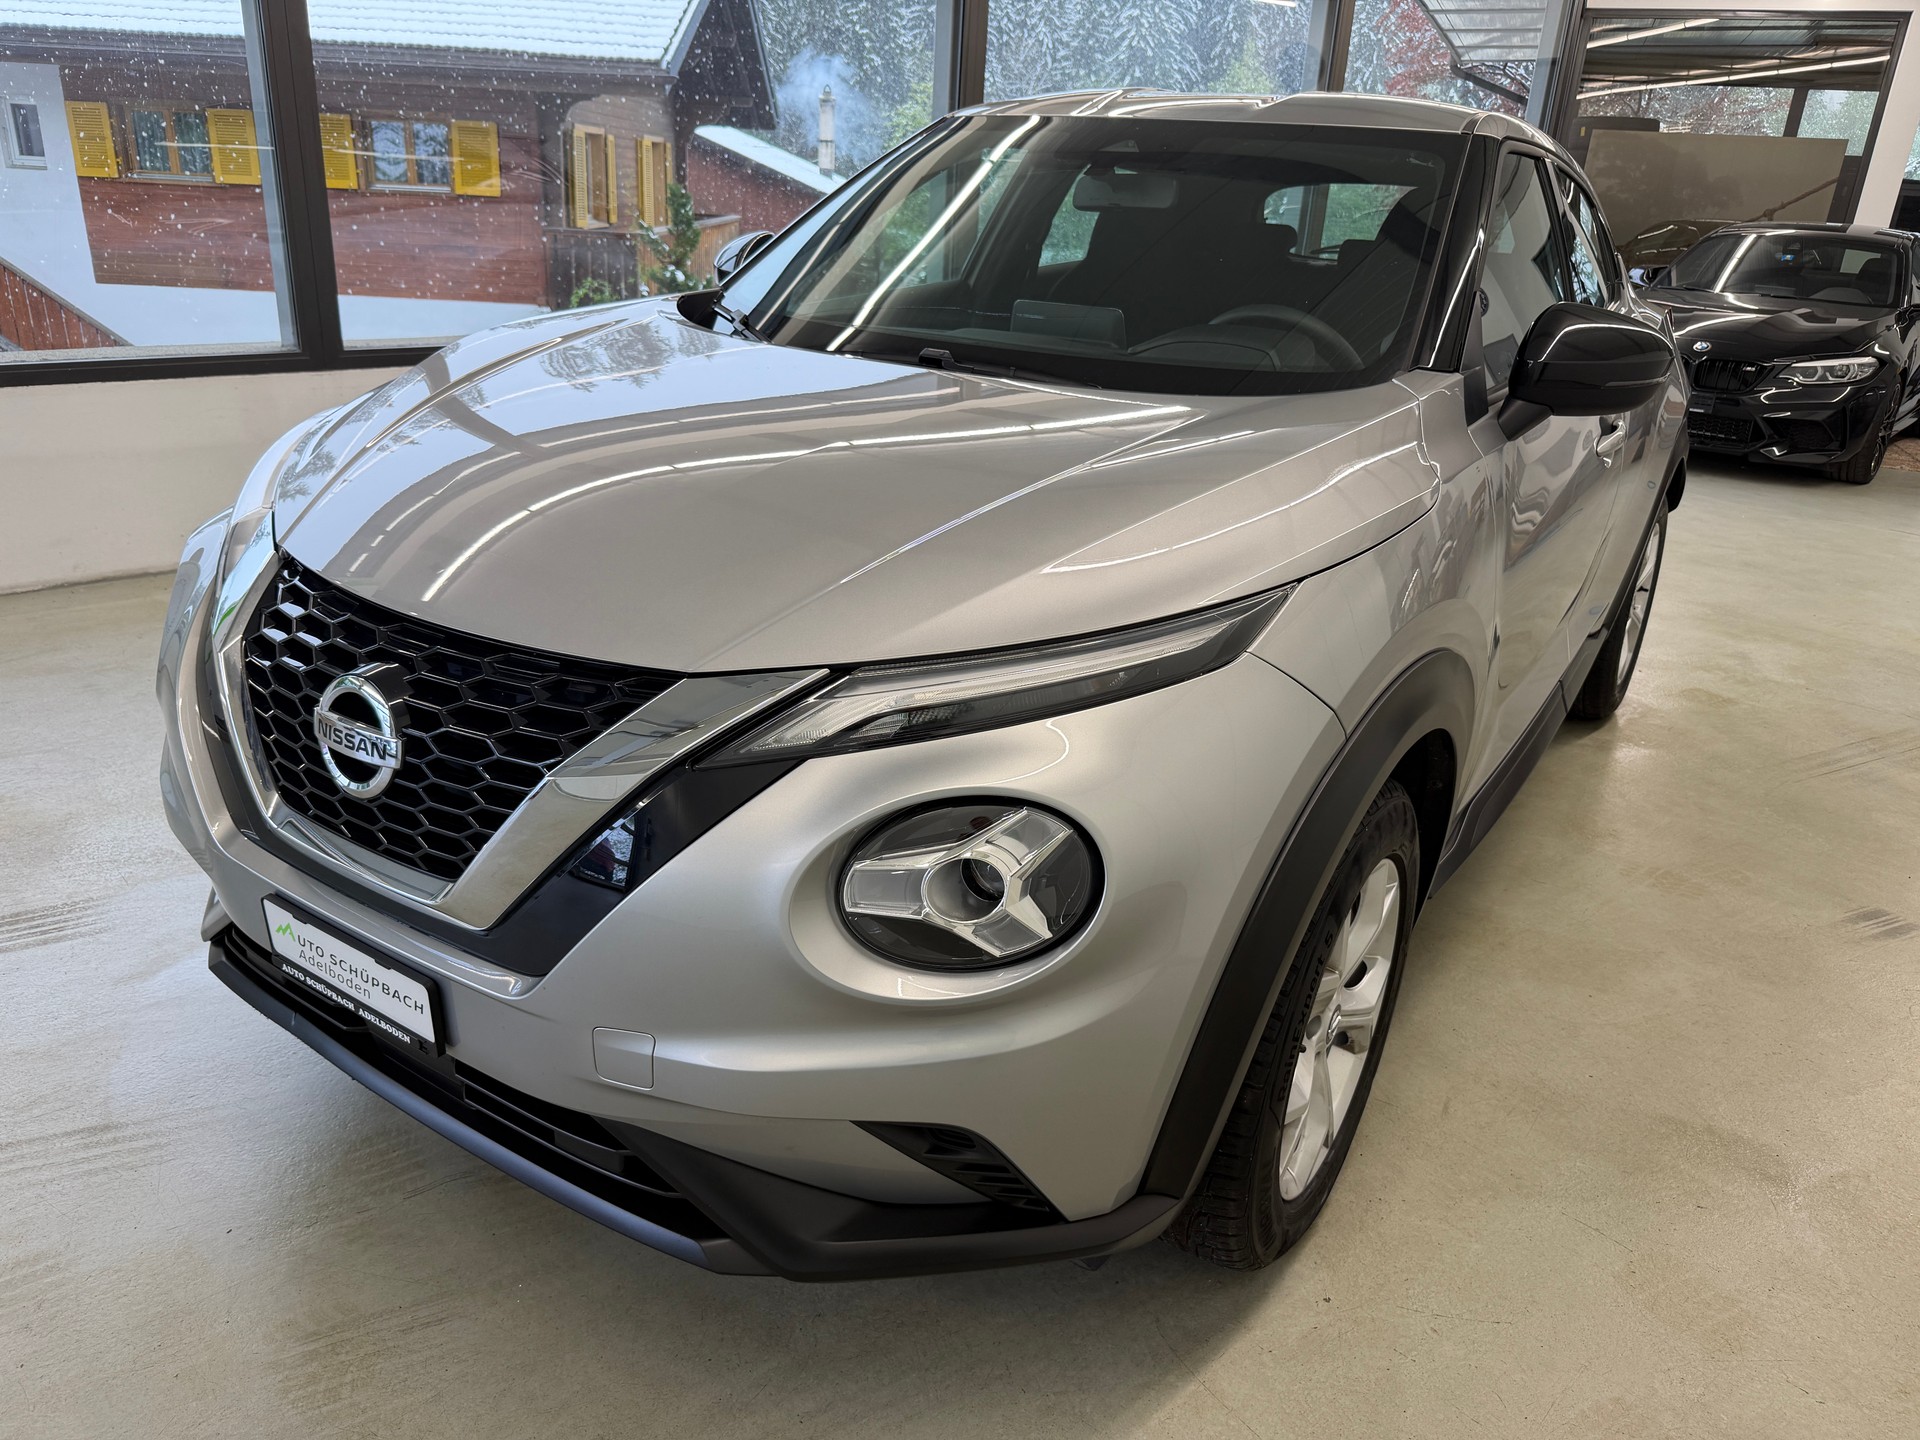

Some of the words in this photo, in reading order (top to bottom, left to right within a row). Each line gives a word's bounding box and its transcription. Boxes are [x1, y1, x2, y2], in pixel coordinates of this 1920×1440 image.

[318, 717, 387, 760] NISSAN
[282, 963, 305, 981] AUTO
[306, 976, 355, 1011] SCHÜPBACH
[359, 1008, 411, 1044] ADELBODEN
[299, 949, 371, 999] Adelboden
[329, 953, 424, 1015] SCHÜPBACH
[1278, 954, 1326, 1102] RainExpert
